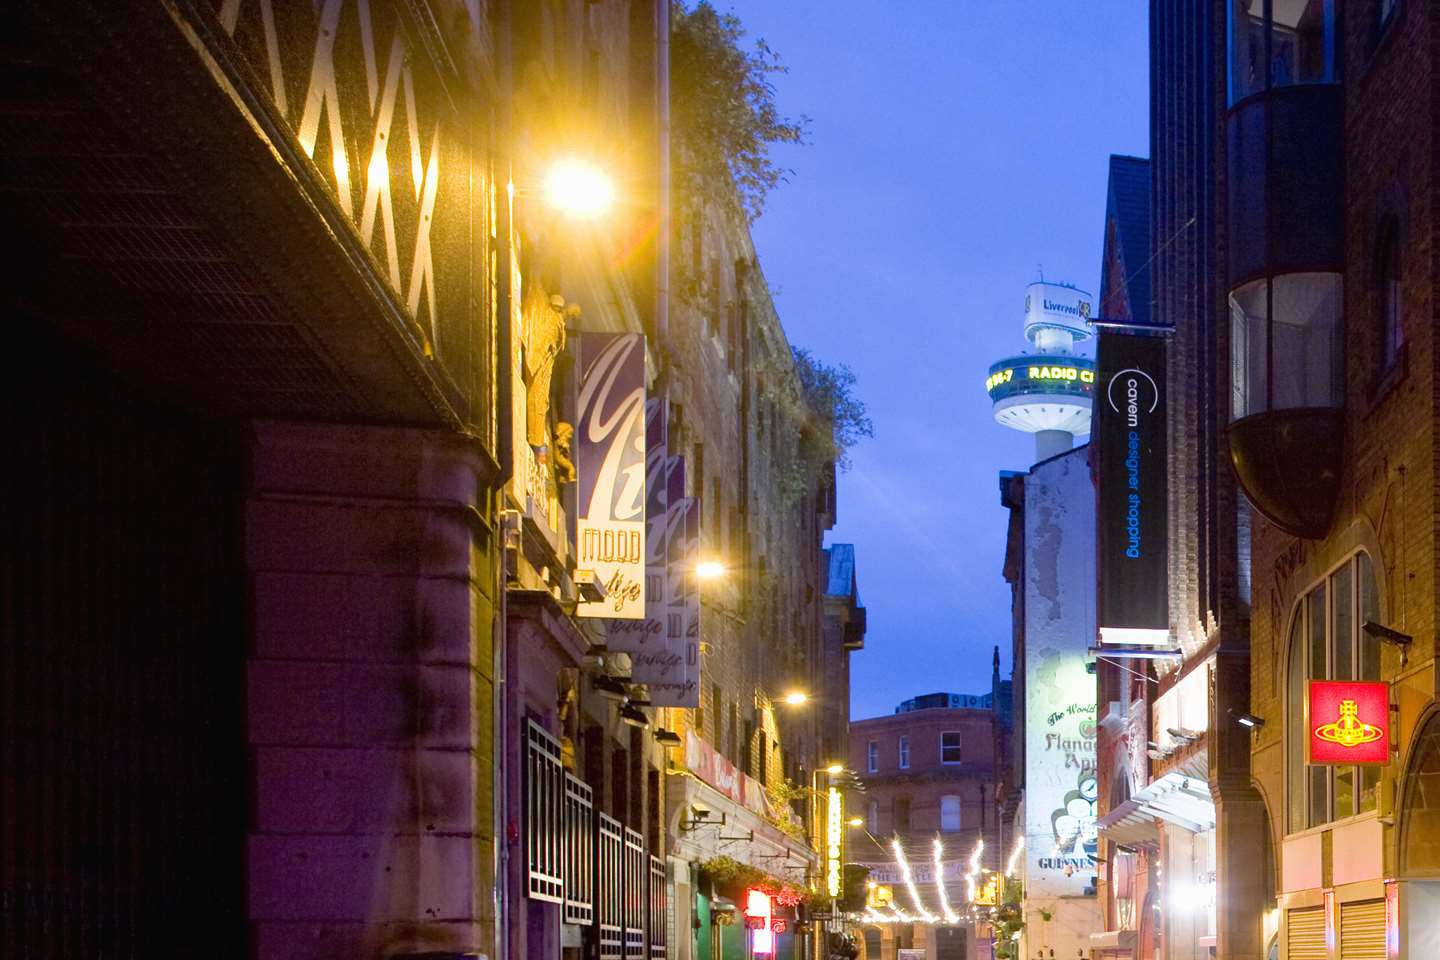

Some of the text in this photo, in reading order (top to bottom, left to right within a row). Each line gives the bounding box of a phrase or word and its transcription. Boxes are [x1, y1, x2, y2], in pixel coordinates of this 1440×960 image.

[1043, 299, 1079, 317] Liverpool
[1029, 367, 1077, 380] RADIO
[1126, 379, 1140, 559] cavern designer shopping
[1047, 712, 1064, 727] The
